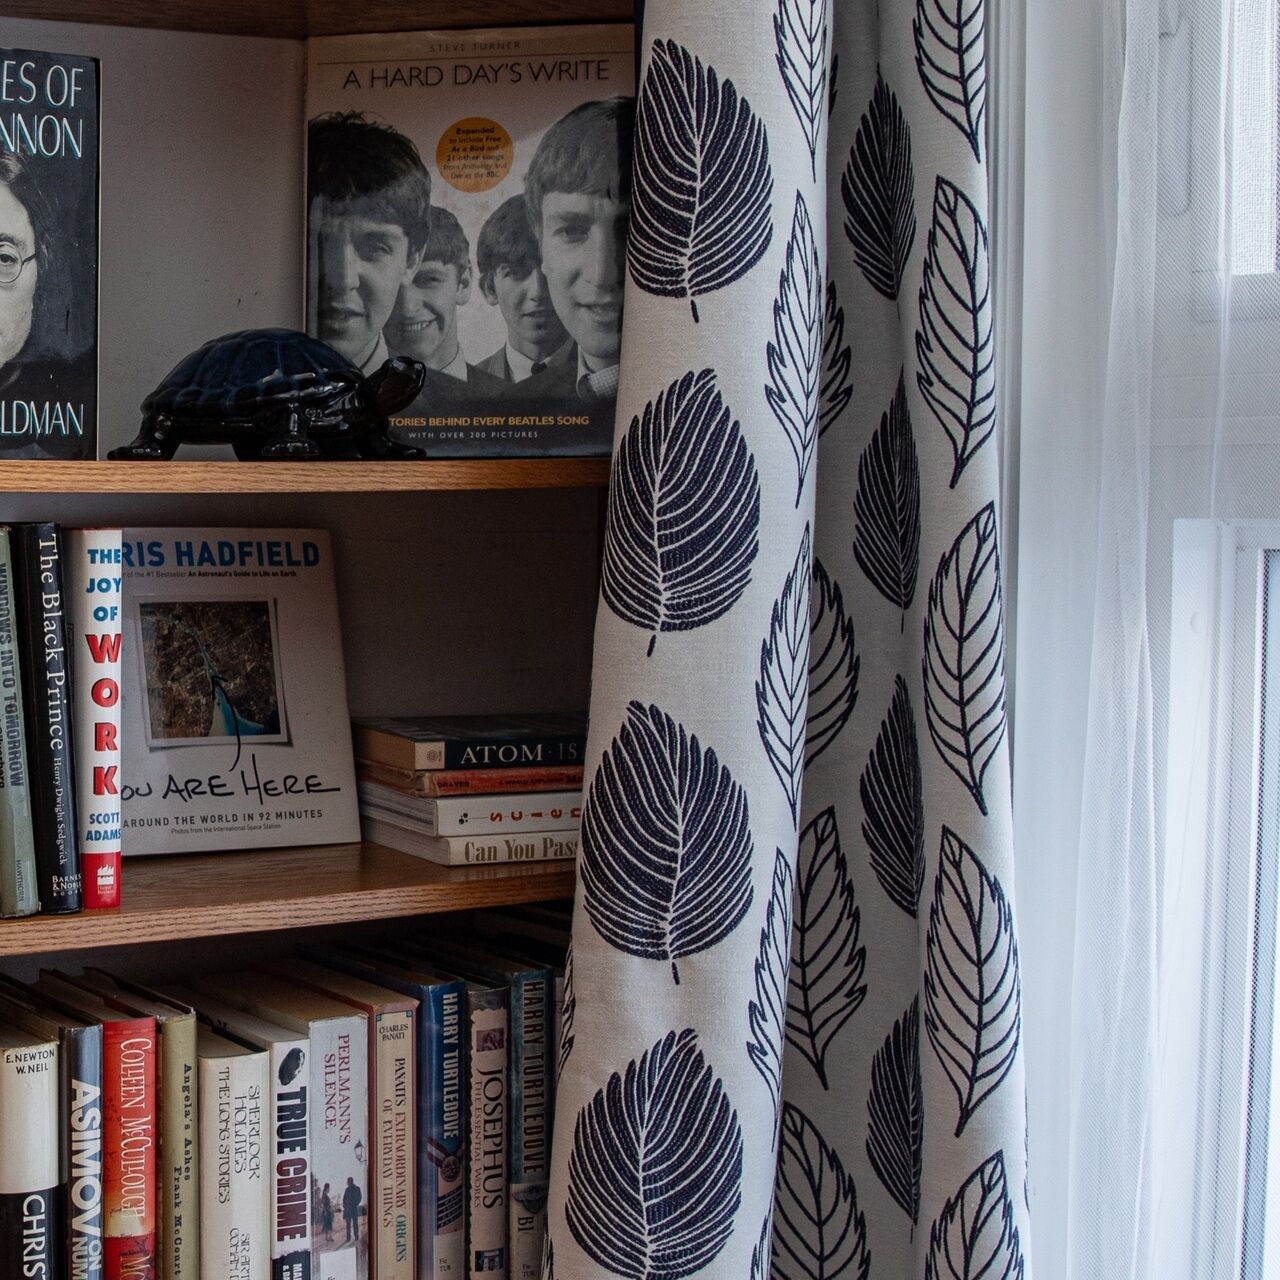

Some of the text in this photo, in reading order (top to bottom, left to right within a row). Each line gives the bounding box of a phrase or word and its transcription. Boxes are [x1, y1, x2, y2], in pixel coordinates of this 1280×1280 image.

[45, 66, 84, 107] OF
[343, 59, 610, 90] A HARD DAY'S WRITE
[409, 431, 435, 439] WITH
[439, 431, 466, 439] OVER
[491, 430, 539, 438] PICTURES
[87, 549, 122, 564] THE
[176, 541, 320, 568] HADFIELD
[86, 577, 122, 594] JOY
[93, 605, 118, 621] OF
[38, 533, 66, 752] The Black Prince
[85, 633, 122, 796] WORK
[459, 745, 543, 764] ATOM
[162, 754, 342, 805] ARE HERE
[89, 812, 120, 825] SCOTT
[123, 809, 324, 828] AROUND THE WORLD IN 92 MINUTES
[85, 829, 121, 841] ADAMS
[443, 993, 460, 1140] HARRY TURTLEDOVE
[481, 1066, 504, 1210] JOSEPHUS
[70, 1080, 102, 1271] ASIMOV ON
[276, 1086, 308, 1243] TRUE CRIME
